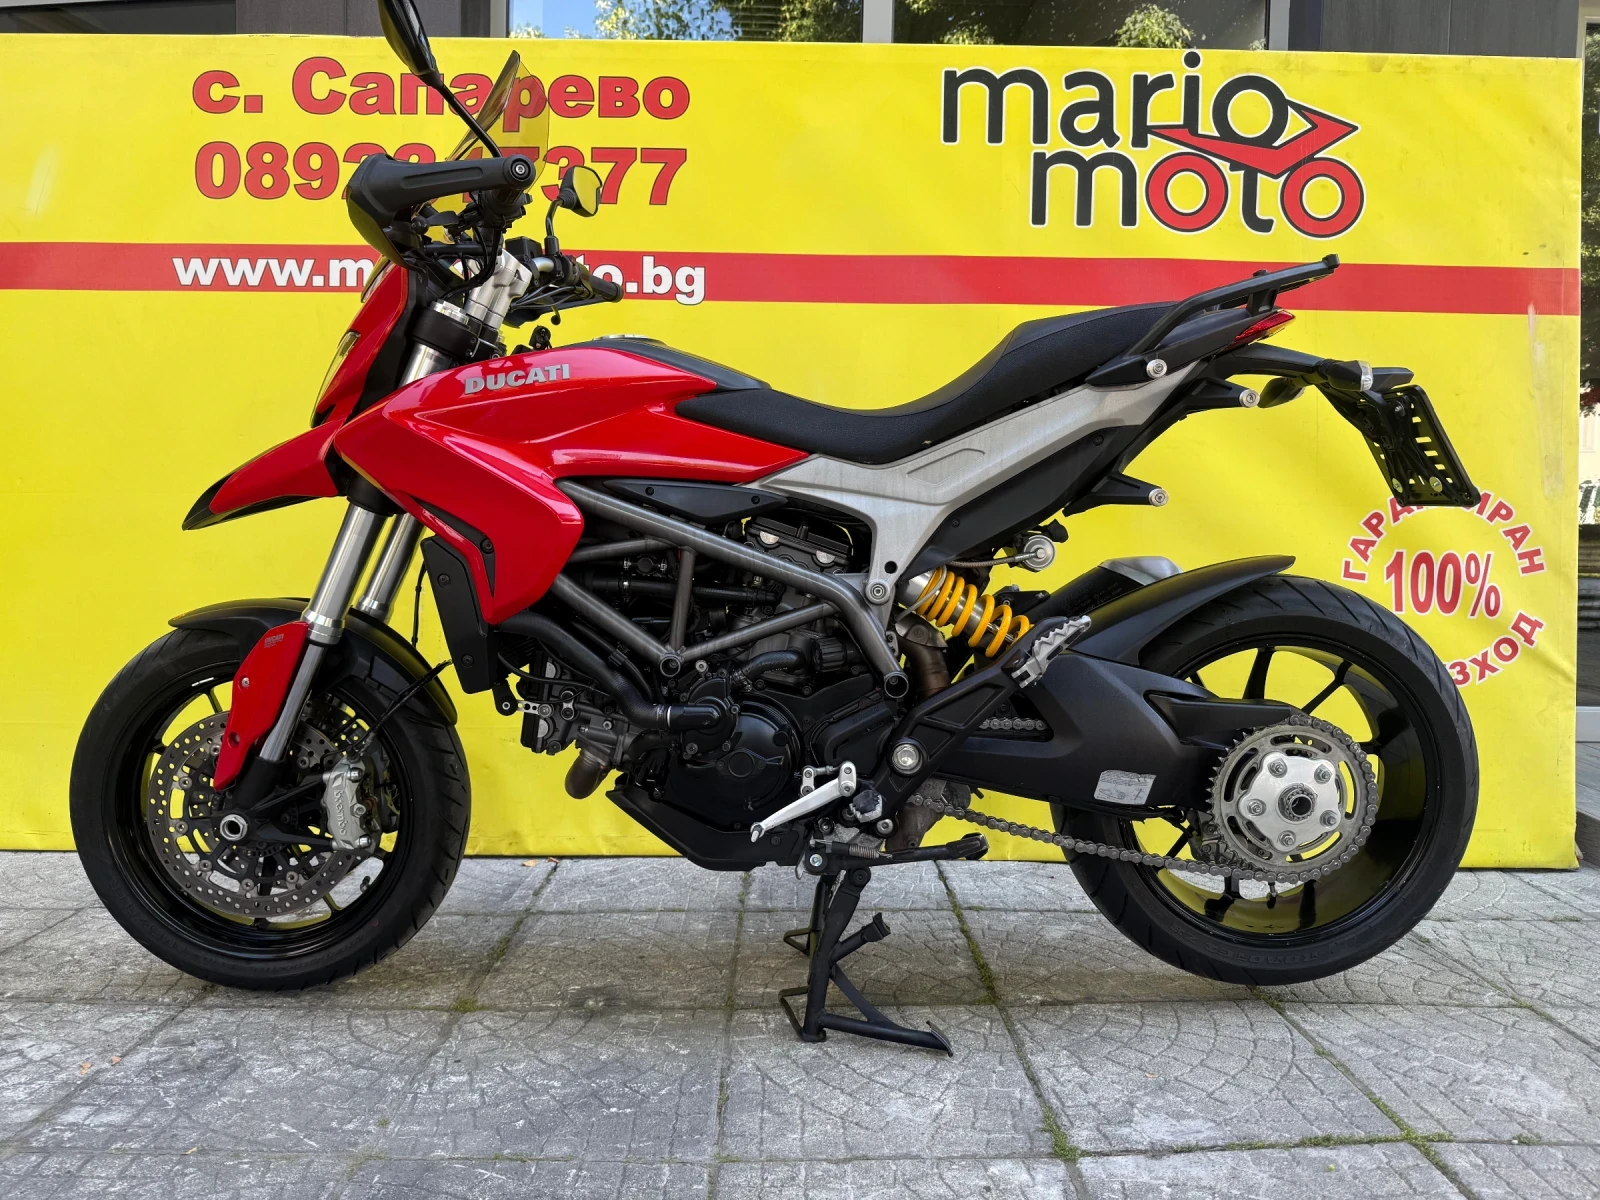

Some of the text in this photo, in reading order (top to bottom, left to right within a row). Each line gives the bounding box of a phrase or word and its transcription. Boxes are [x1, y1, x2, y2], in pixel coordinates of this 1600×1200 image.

[942, 50, 1290, 148] mario
[195, 140, 688, 206] 089377
[1031, 150, 1365, 238] moto
[171, 254, 706, 306] www.mo.bg
[464, 363, 571, 395] DUCATI
[1385, 551, 1501, 617] 100%
[334, 790, 347, 836] brembo
